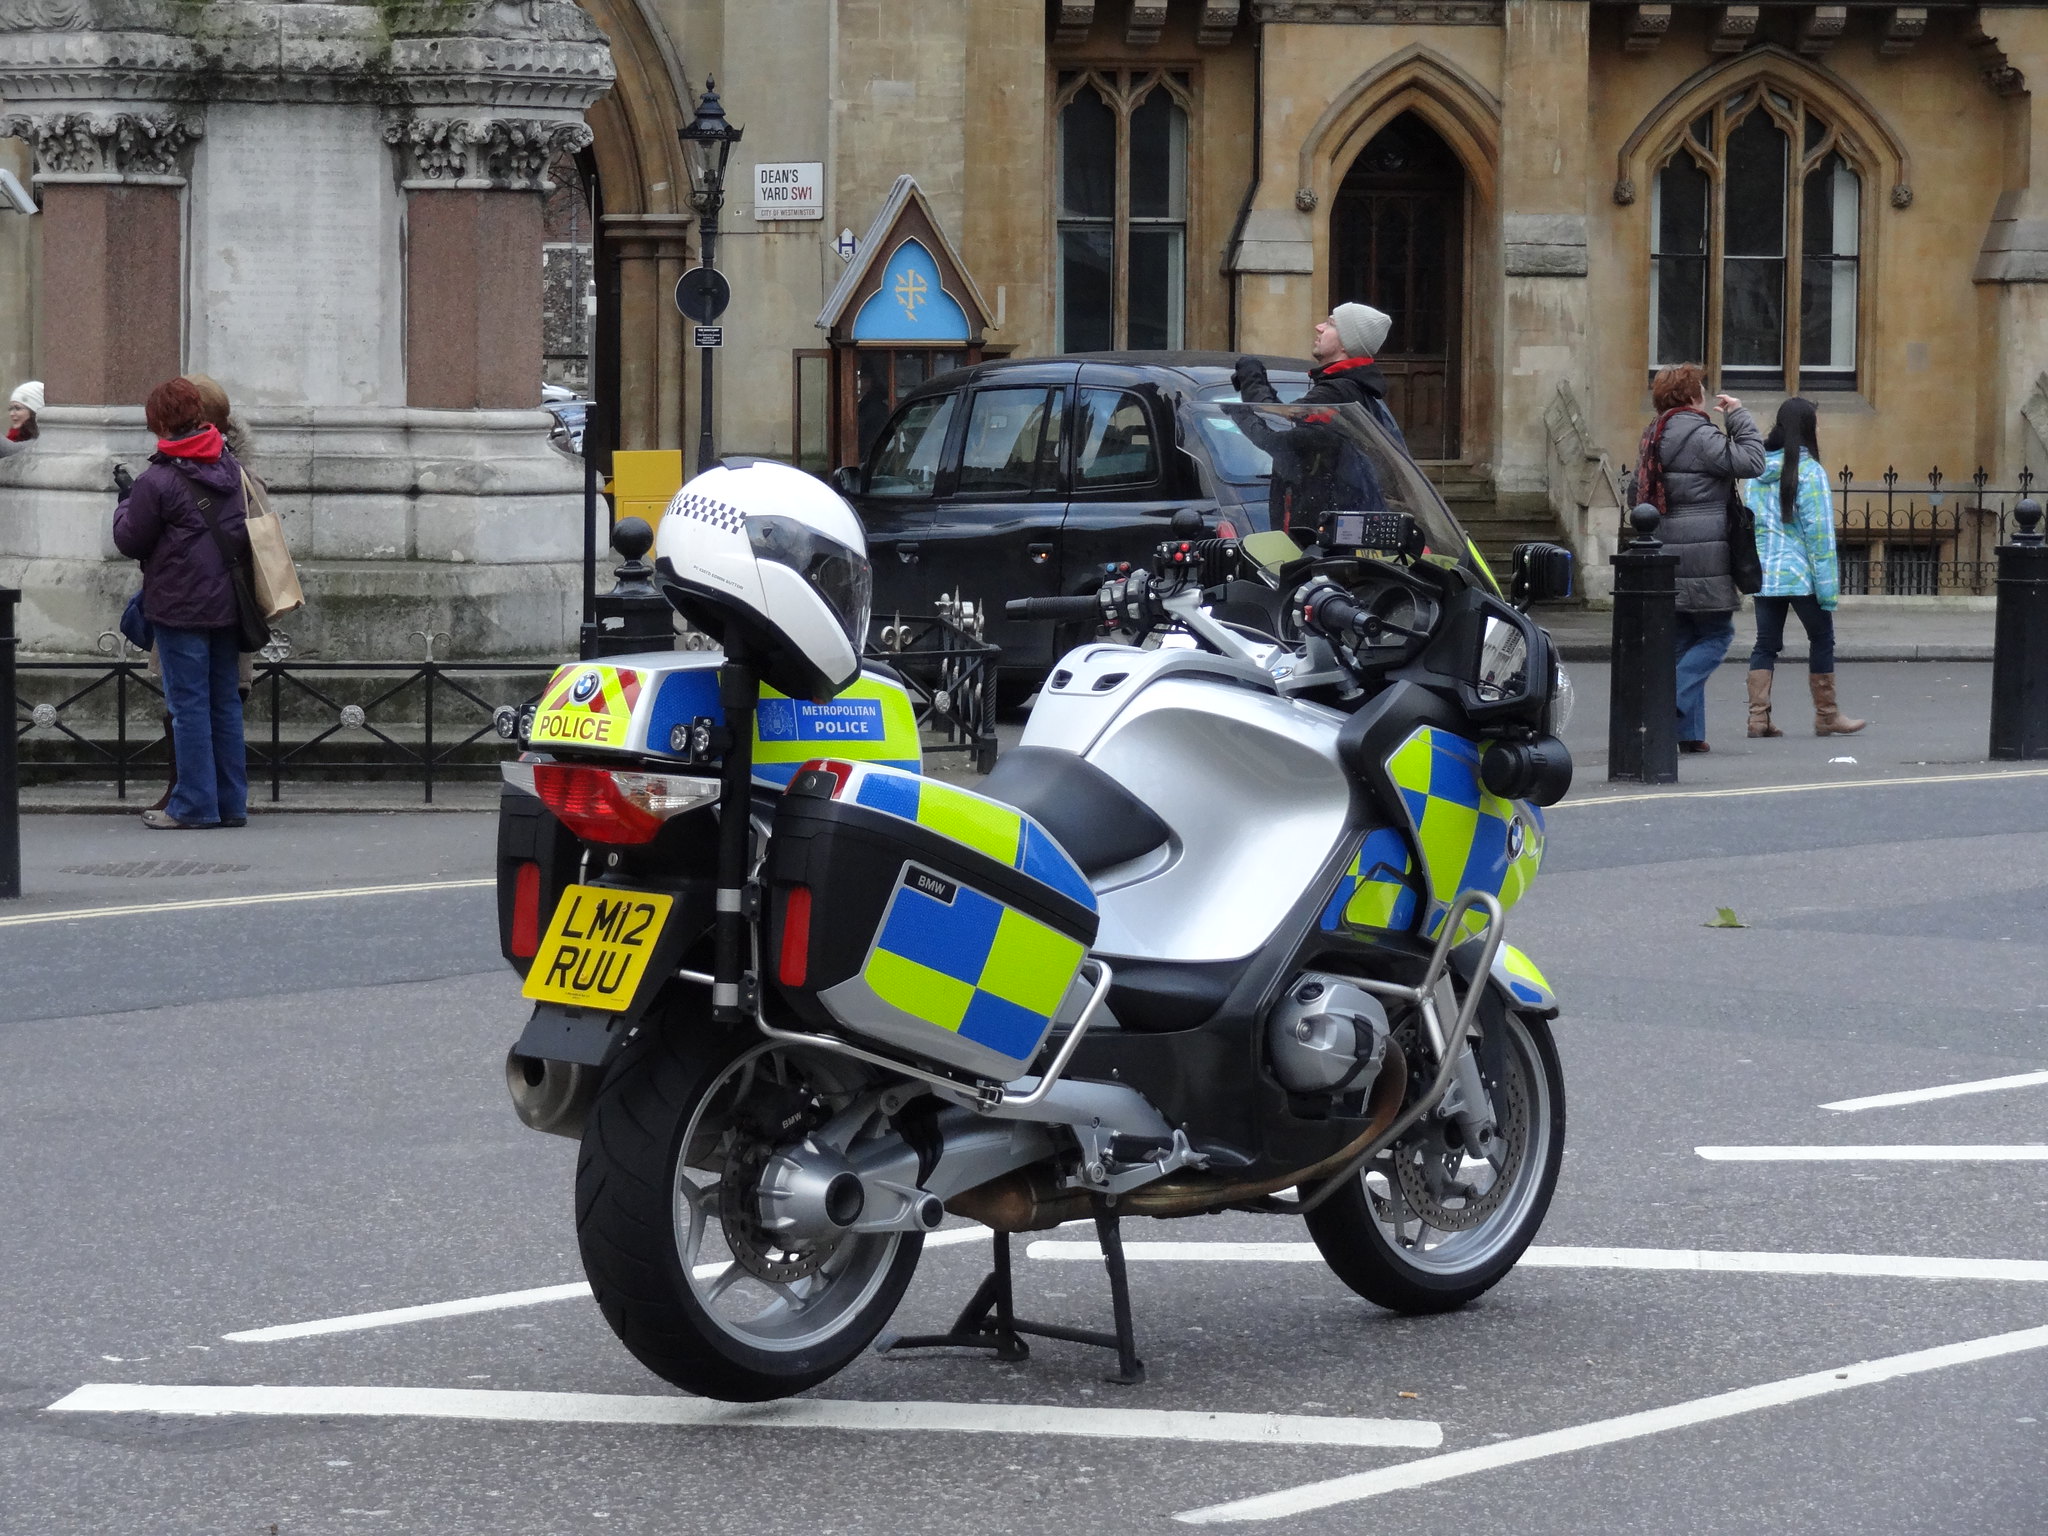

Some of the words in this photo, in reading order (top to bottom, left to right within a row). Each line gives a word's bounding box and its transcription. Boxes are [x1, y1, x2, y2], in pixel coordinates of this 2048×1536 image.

[761, 169, 799, 184] DEAN'S
[761, 187, 789, 201] YARD
[791, 186, 813, 201] SW1
[838, 235, 856, 254] H
[844, 250, 850, 259] 5
[802, 705, 877, 717] METROPOLITAN
[539, 714, 612, 742] POLICE
[814, 721, 869, 734] POLICE
[917, 874, 946, 895] BMW
[560, 895, 657, 947] LM12
[544, 944, 633, 995] RUU
[782, 1111, 802, 1129] BMW
